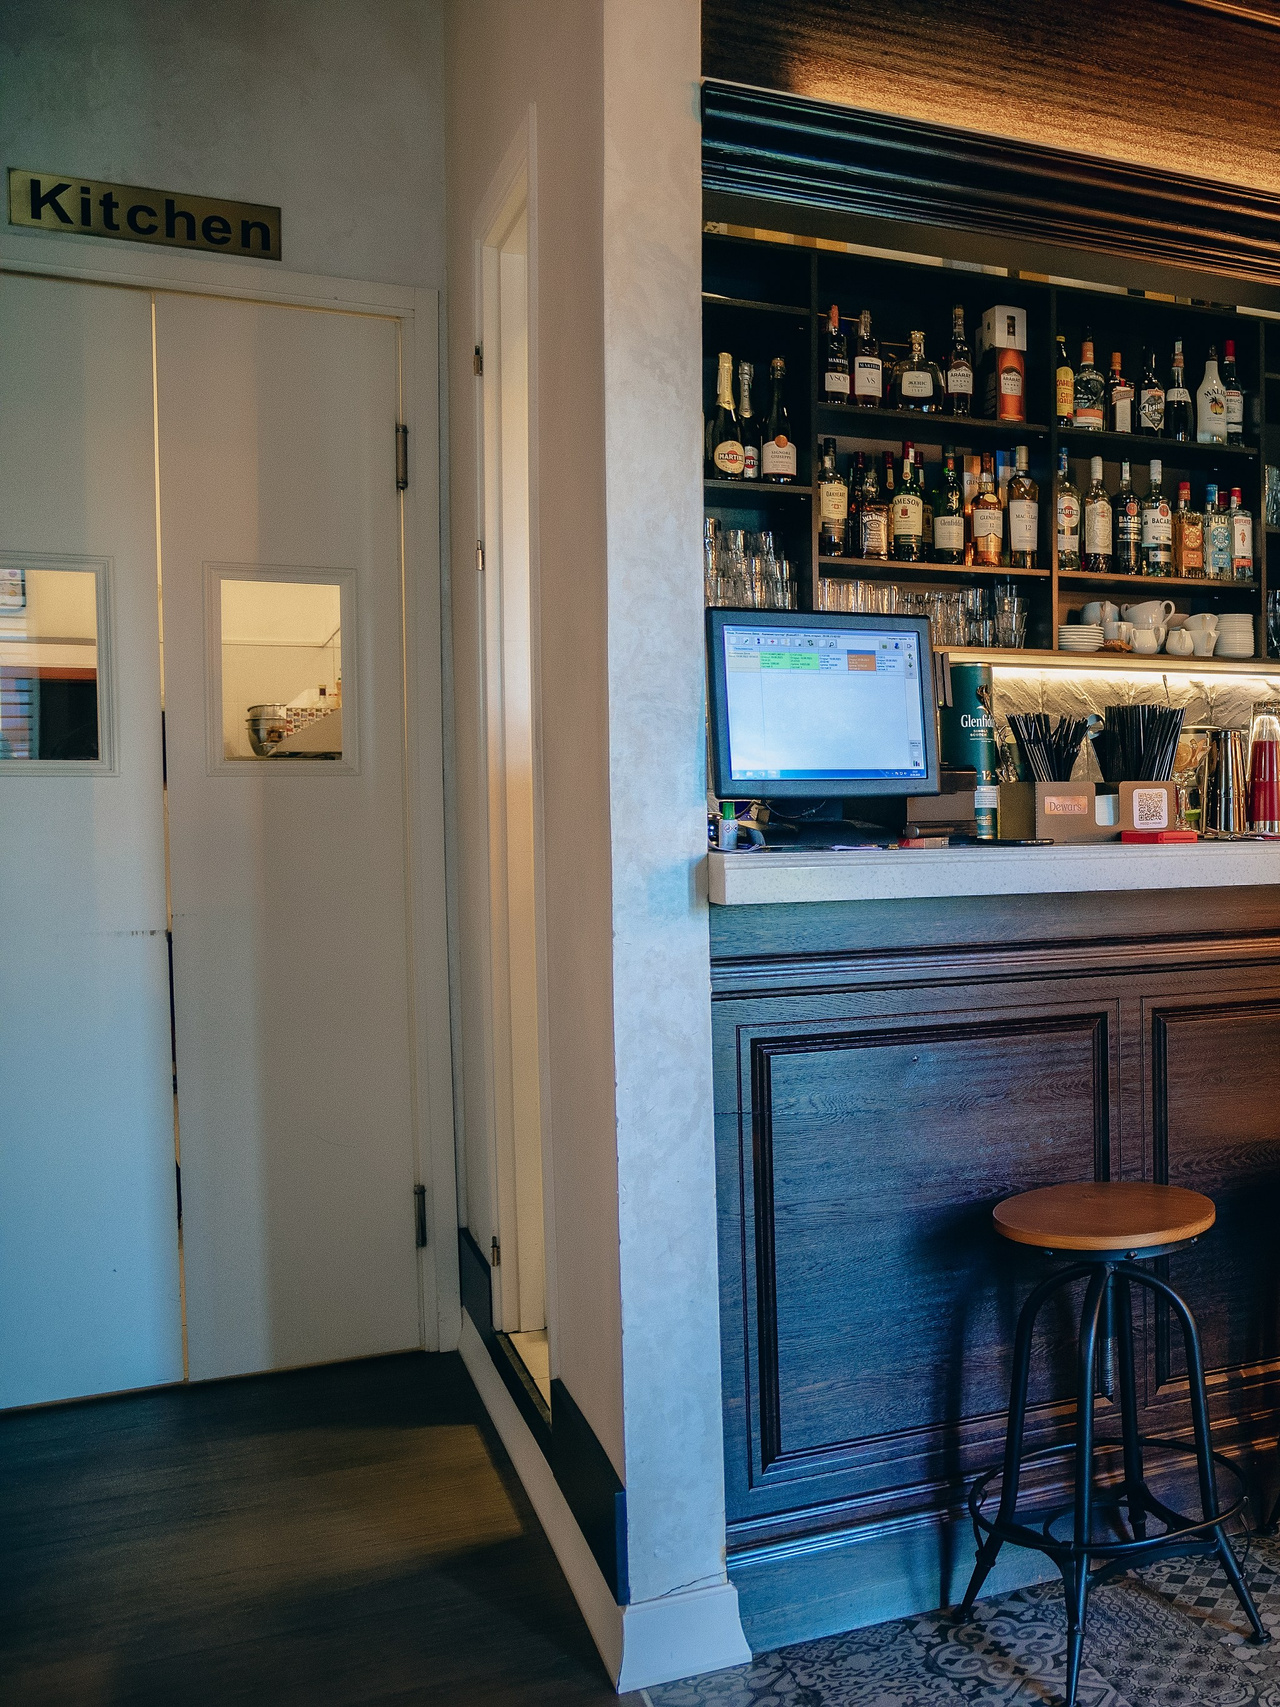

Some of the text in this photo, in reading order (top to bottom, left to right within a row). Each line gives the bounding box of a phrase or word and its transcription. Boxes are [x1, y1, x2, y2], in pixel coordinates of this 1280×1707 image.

[30, 178, 271, 252] Kitchen
[893, 498, 919, 507] AMESON
[982, 770, 992, 780] 12
[1049, 801, 1082, 812] Dewar's
